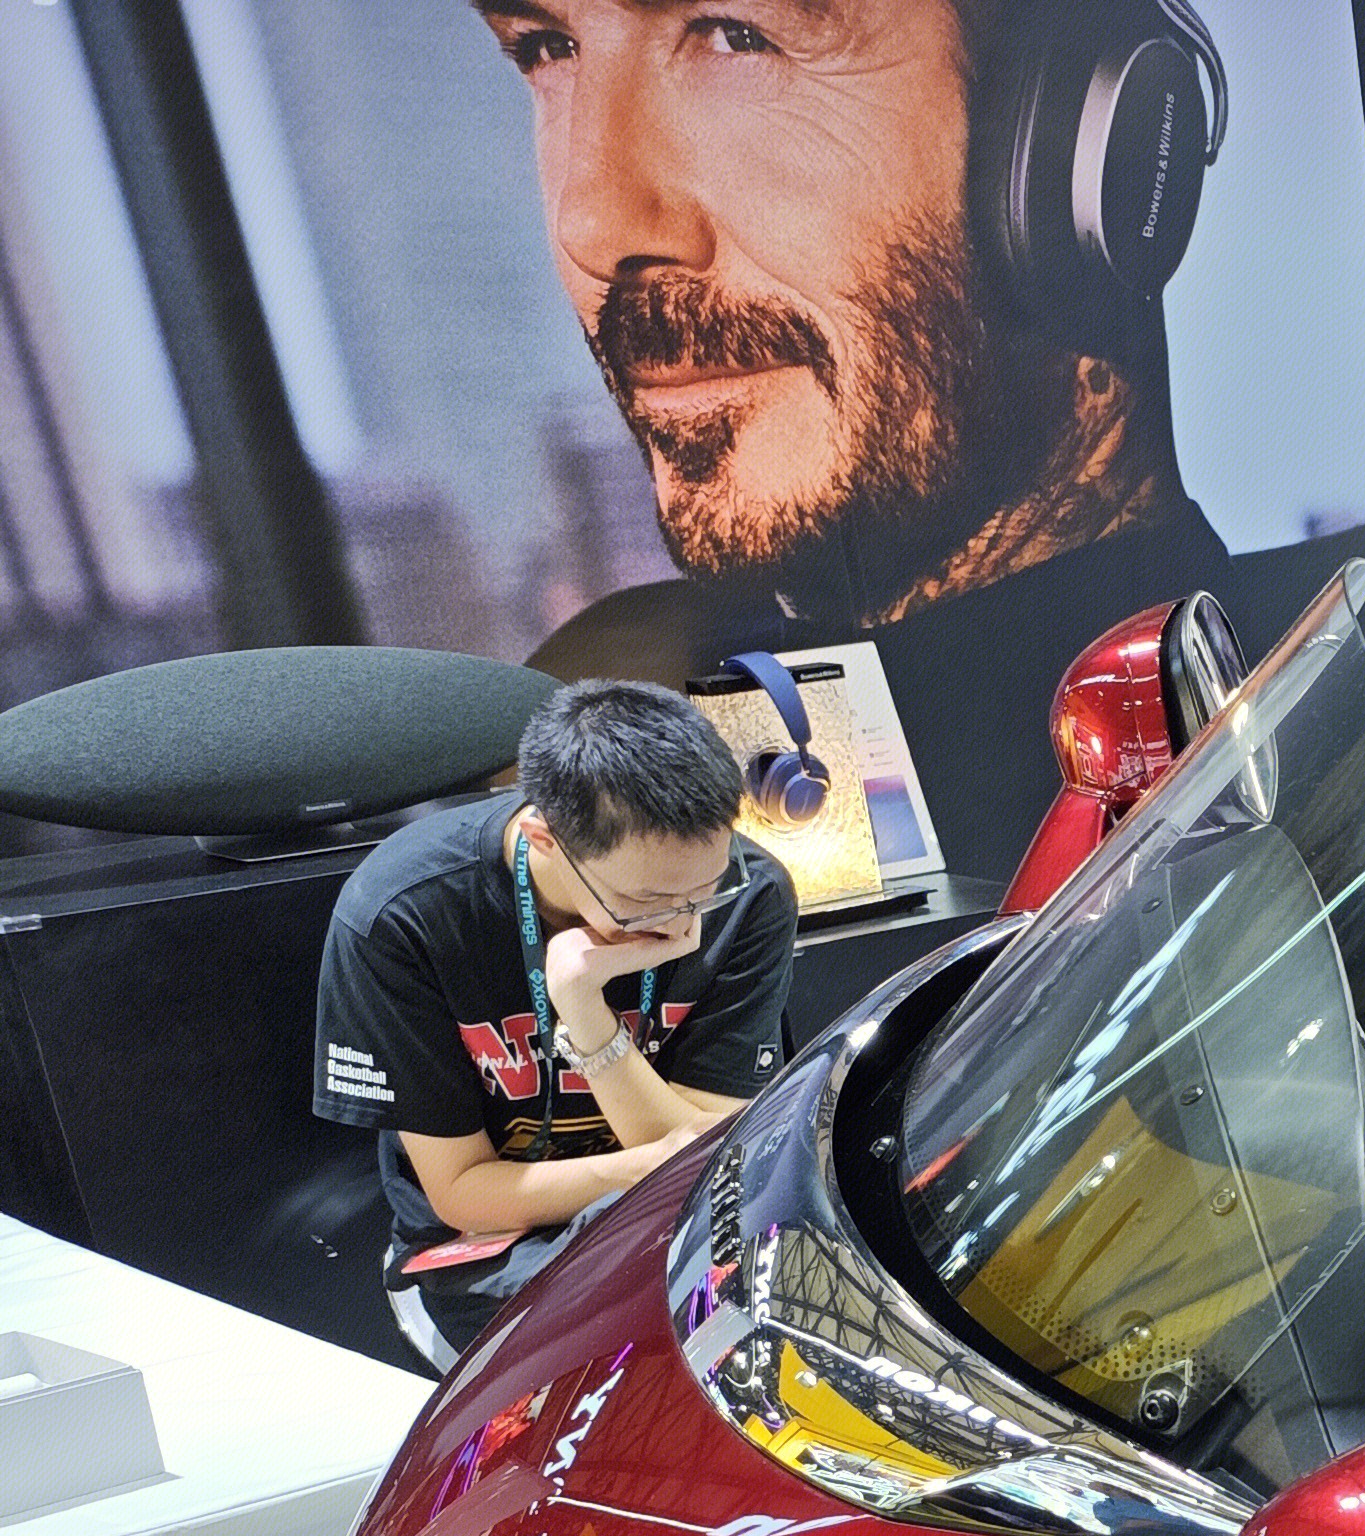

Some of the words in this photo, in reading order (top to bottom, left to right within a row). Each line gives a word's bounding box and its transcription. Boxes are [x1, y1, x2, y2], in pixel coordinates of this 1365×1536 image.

[1157, 92, 1175, 156] Wilkins
[1158, 160, 1168, 171] &
[1142, 171, 1166, 238] Bowers
[517, 855, 529, 887] The
[519, 889, 538, 946] Things
[328, 1043, 374, 1067] National
[327, 1059, 387, 1085] Basketball
[326, 1076, 395, 1102] Association
